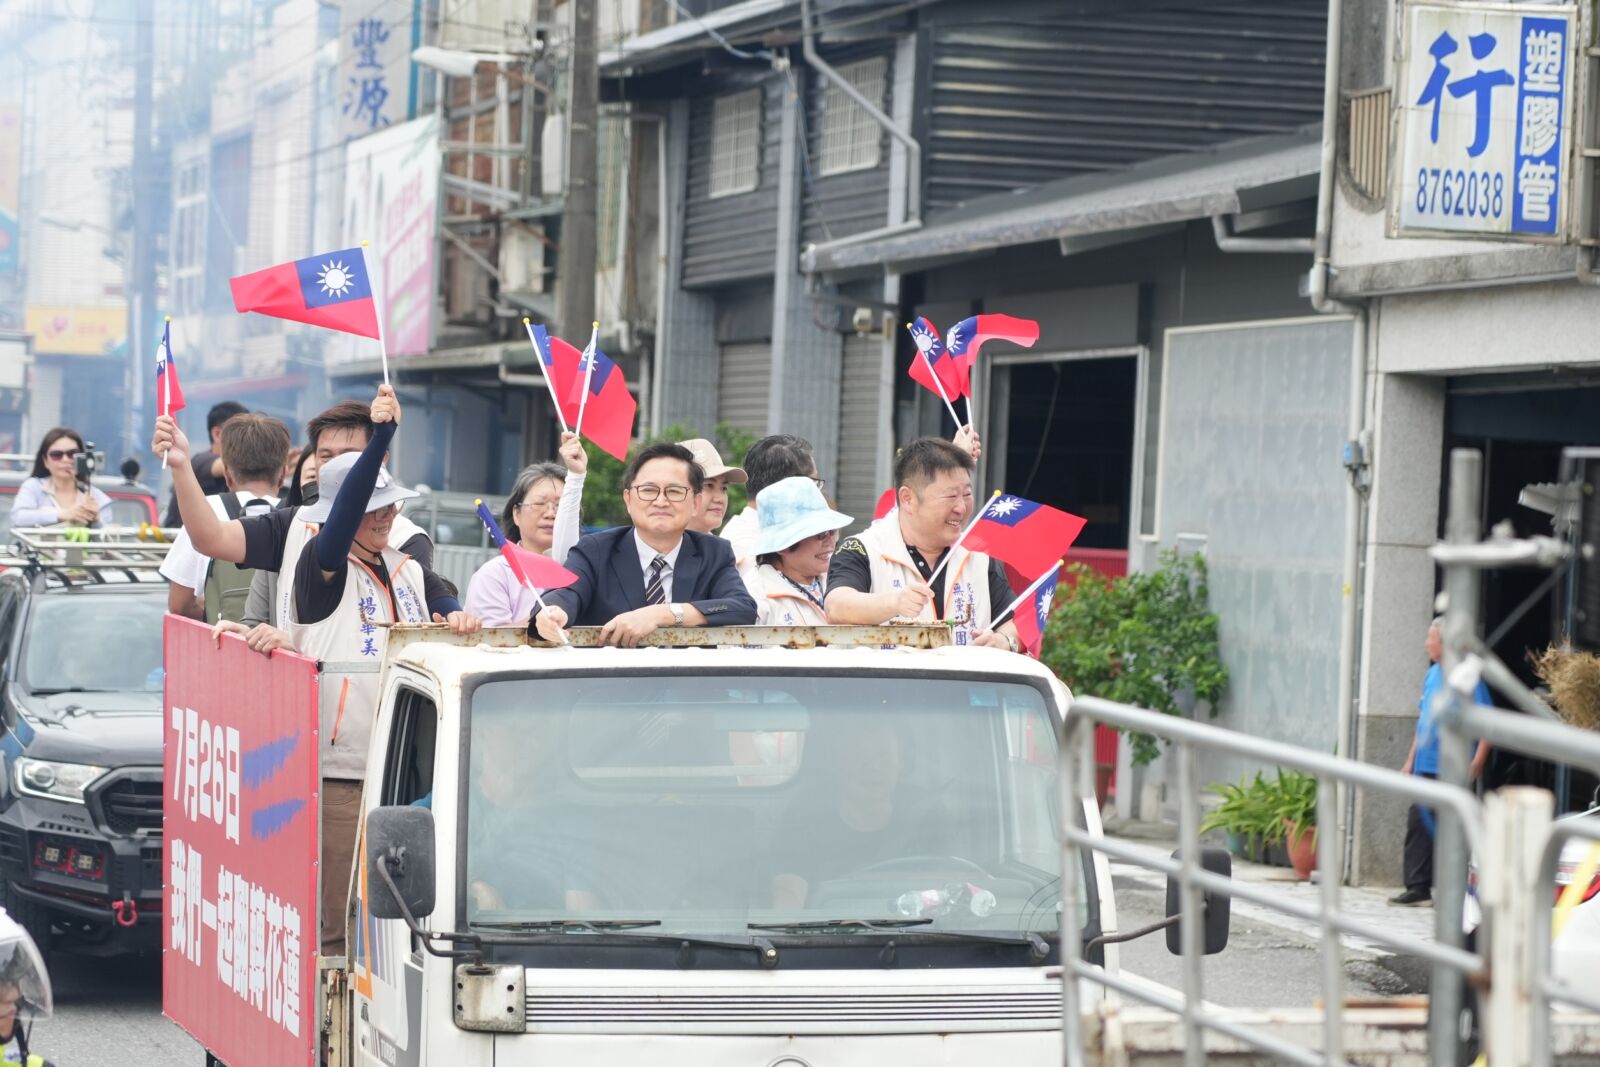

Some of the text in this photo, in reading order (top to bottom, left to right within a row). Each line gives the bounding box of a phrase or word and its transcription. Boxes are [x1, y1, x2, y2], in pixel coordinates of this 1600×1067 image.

[342, 17, 390, 138] 豐源
[1415, 30, 1516, 158] 行
[1518, 28, 1563, 222] 塑膠管
[1416, 167, 1504, 219] 8762038
[171, 705, 241, 846] 7月26日
[171, 838, 301, 1039] 我們一起翻轉花蓮
